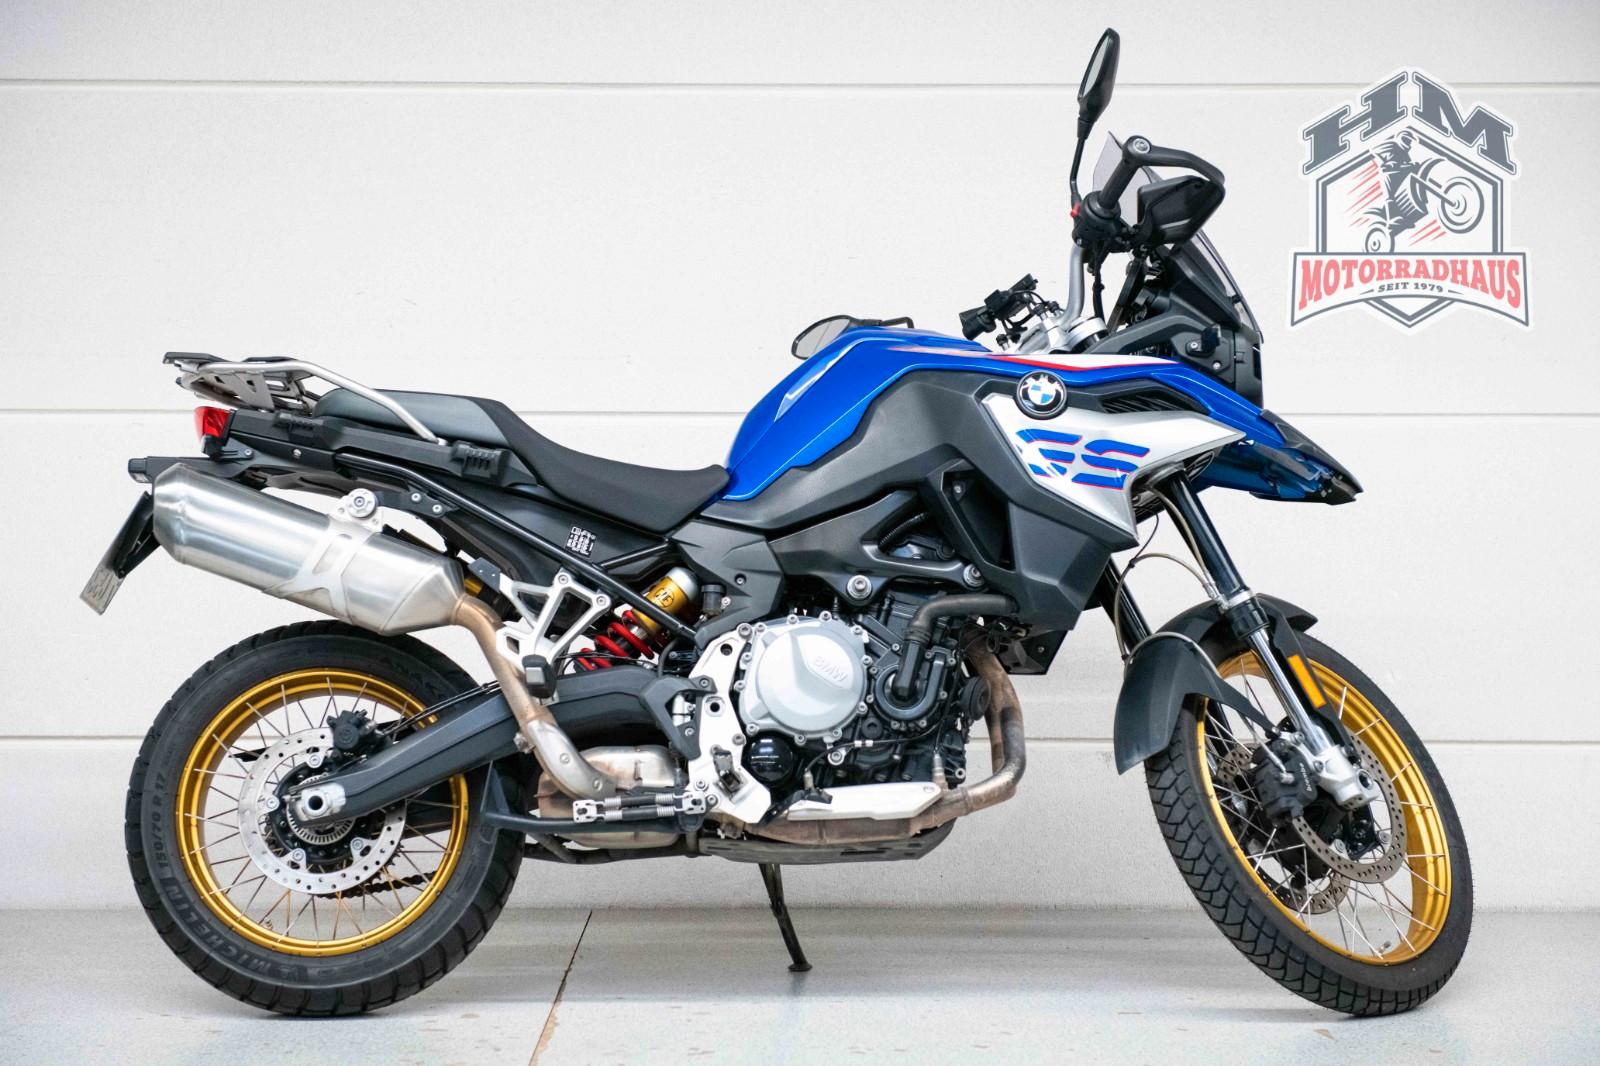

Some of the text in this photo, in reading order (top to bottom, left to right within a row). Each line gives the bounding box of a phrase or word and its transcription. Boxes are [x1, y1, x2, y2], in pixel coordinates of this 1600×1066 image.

[815, 655, 849, 682] BMW
[151, 772, 169, 869] 150/70 R 17
[163, 883, 273, 976] MICHELIN
